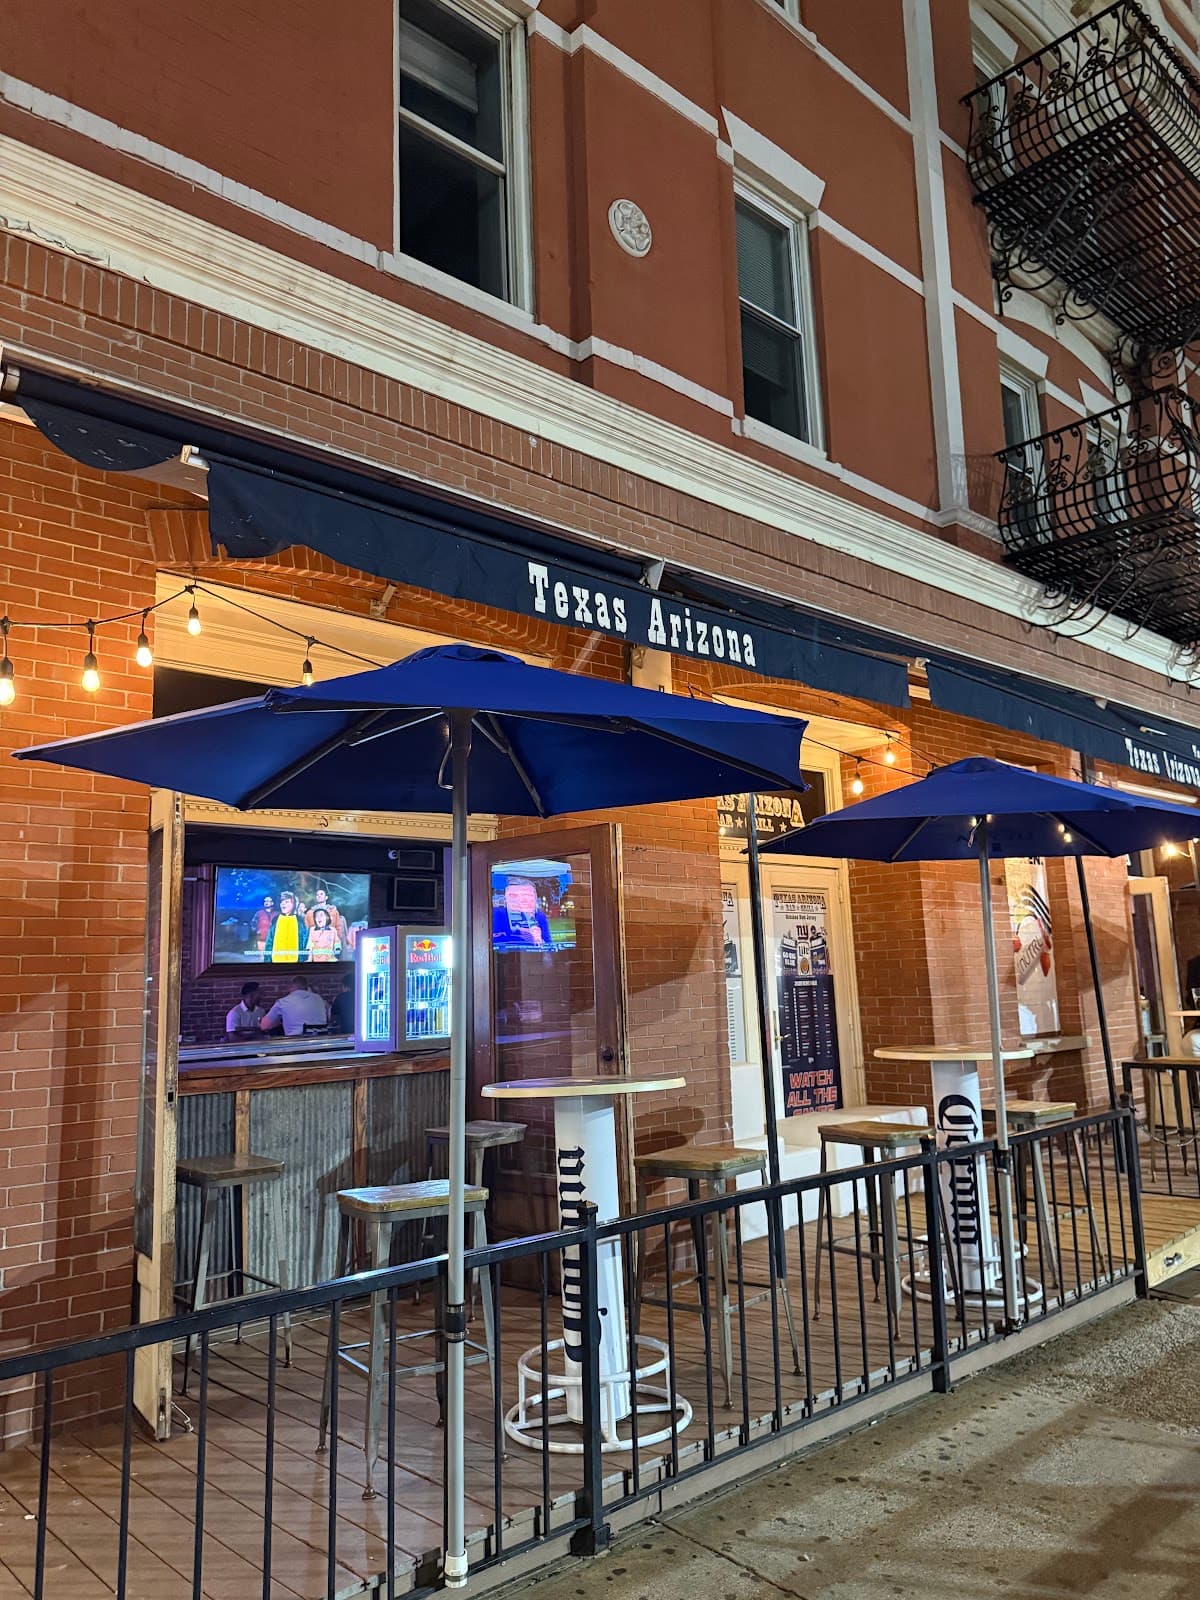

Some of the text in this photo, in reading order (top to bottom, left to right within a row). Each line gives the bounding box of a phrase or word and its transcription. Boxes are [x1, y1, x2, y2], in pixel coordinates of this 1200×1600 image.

[528, 561, 757, 668] Texas Arizona
[1125, 737, 1161, 774] Texas
[737, 791, 805, 828] AIZONA
[787, 1086, 838, 1108] ALL THE
[789, 1069, 834, 1089] WATCH
